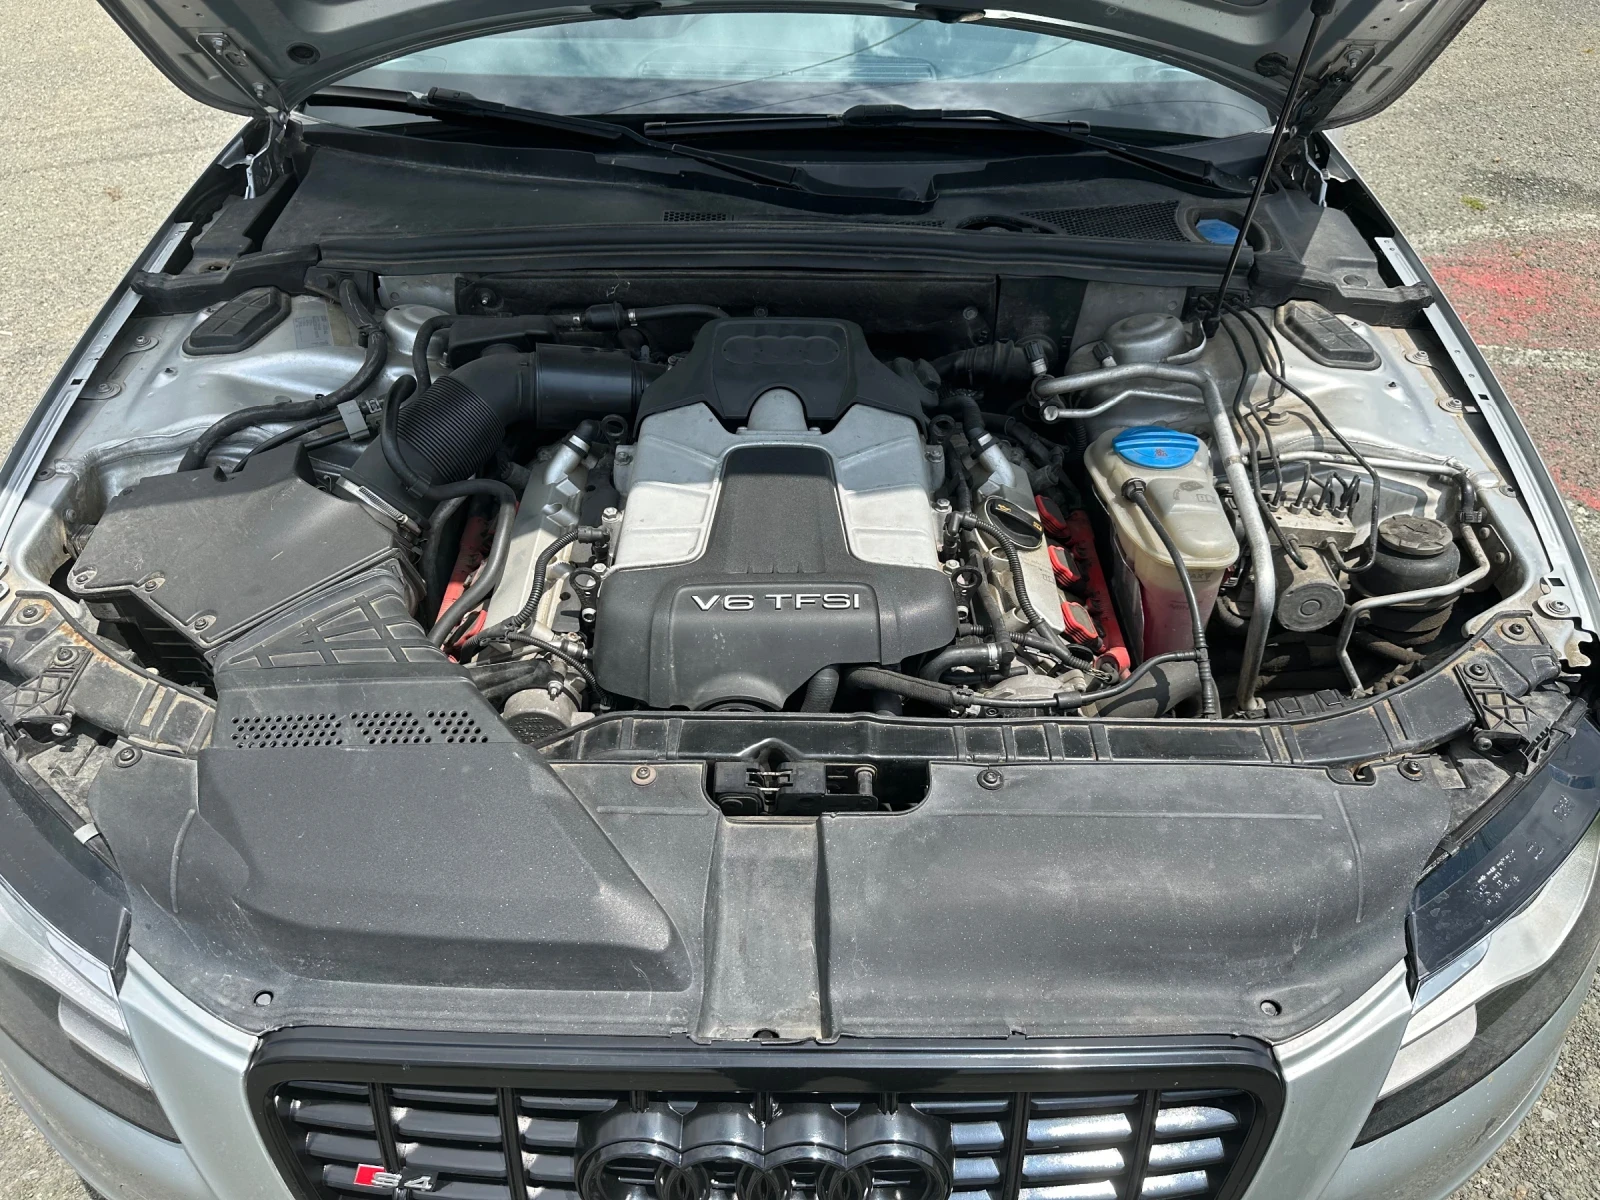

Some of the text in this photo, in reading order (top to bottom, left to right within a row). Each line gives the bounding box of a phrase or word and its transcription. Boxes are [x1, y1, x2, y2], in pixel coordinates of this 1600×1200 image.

[691, 593, 860, 611] V6 TFSI
[371, 1171, 433, 1191] S4
